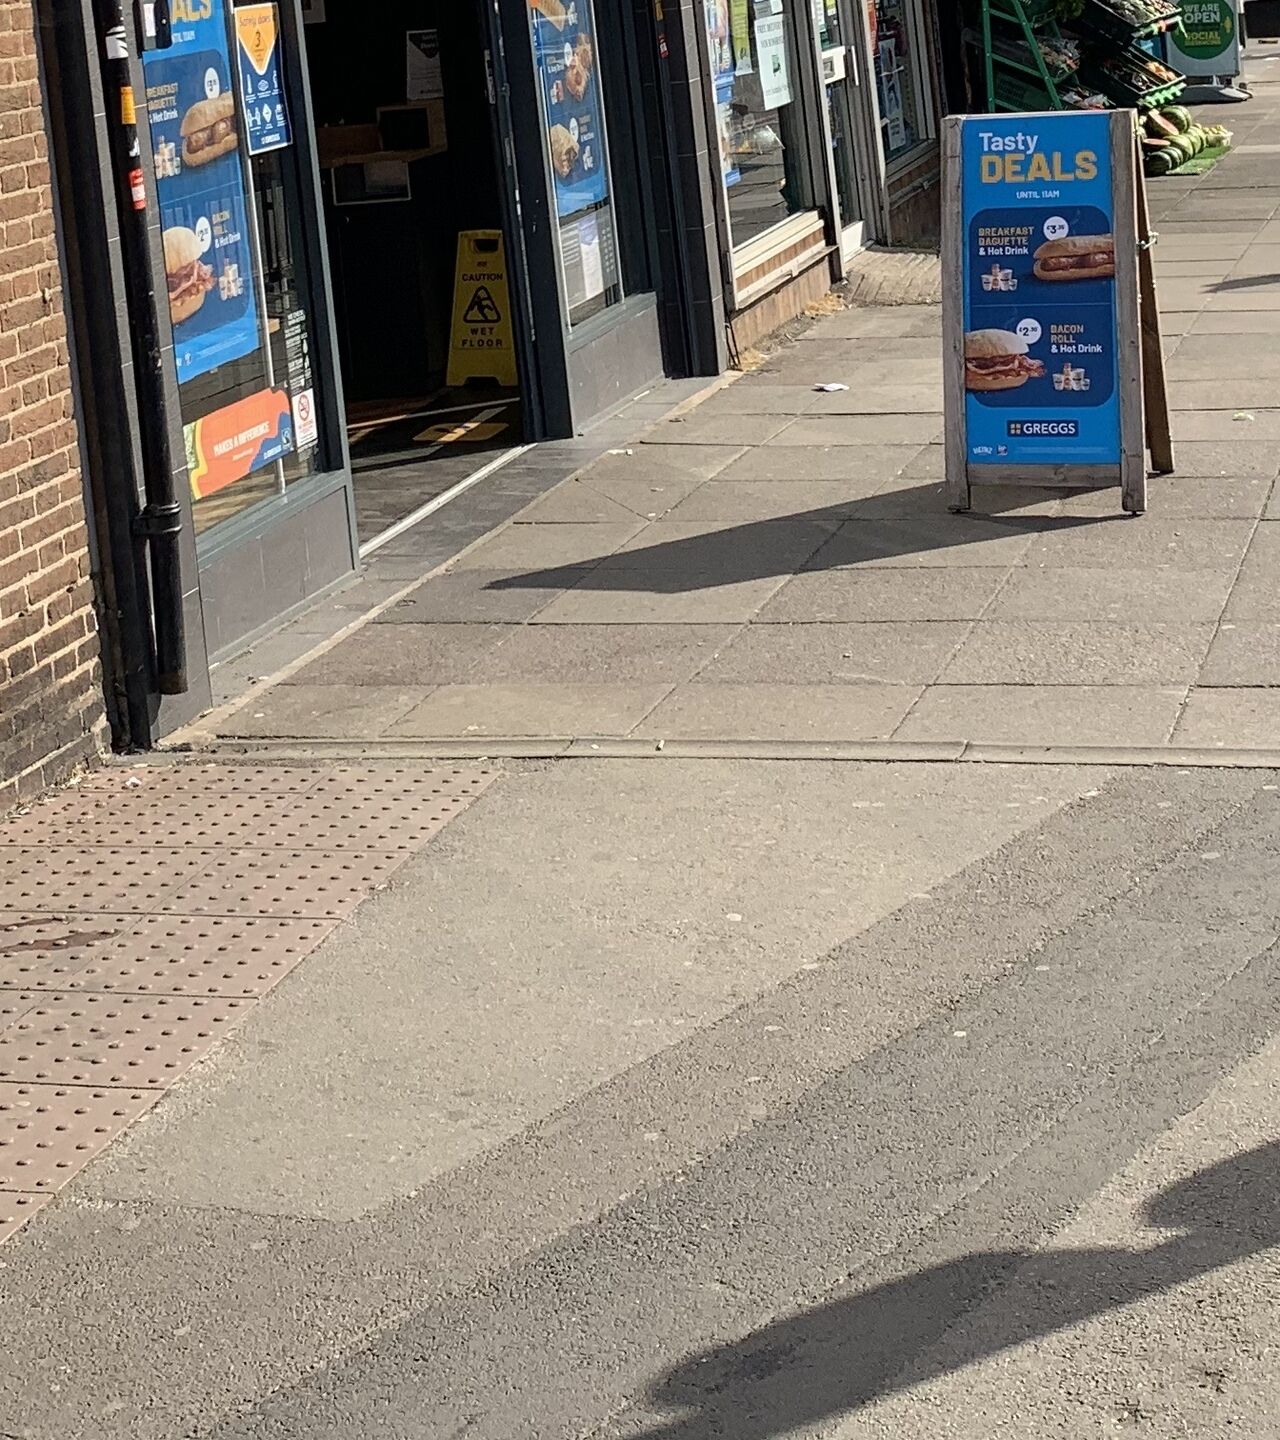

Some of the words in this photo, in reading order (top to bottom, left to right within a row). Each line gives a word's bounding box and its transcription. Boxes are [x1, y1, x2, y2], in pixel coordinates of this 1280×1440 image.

[1183, 4, 1199, 12] WE
[1201, 3, 1220, 12] ARE
[1184, 12, 1220, 23] OPEN
[979, 132, 1039, 154] Tasty
[981, 150, 1098, 184] DEALS
[1016, 191, 1040, 200] UNTIL
[1041, 190, 1060, 199] 11AM
[978, 226, 1034, 237] BREAKFAST
[978, 237, 1028, 247] BAGUETTE
[979, 247, 986, 256] &
[988, 247, 1003, 256] Hot
[1004, 246, 1029, 256] Drink
[462, 273, 503, 281] CAUTION
[470, 327, 495, 335] WET
[1050, 324, 1084, 334] BACON
[462, 339, 503, 347] FLOOR
[1051, 334, 1076, 344] ROLL
[1051, 344, 1059, 354] &
[1060, 344, 1076, 353] Hot
[1078, 343, 1102, 353] Drink
[1023, 422, 1076, 435] GREGGS
